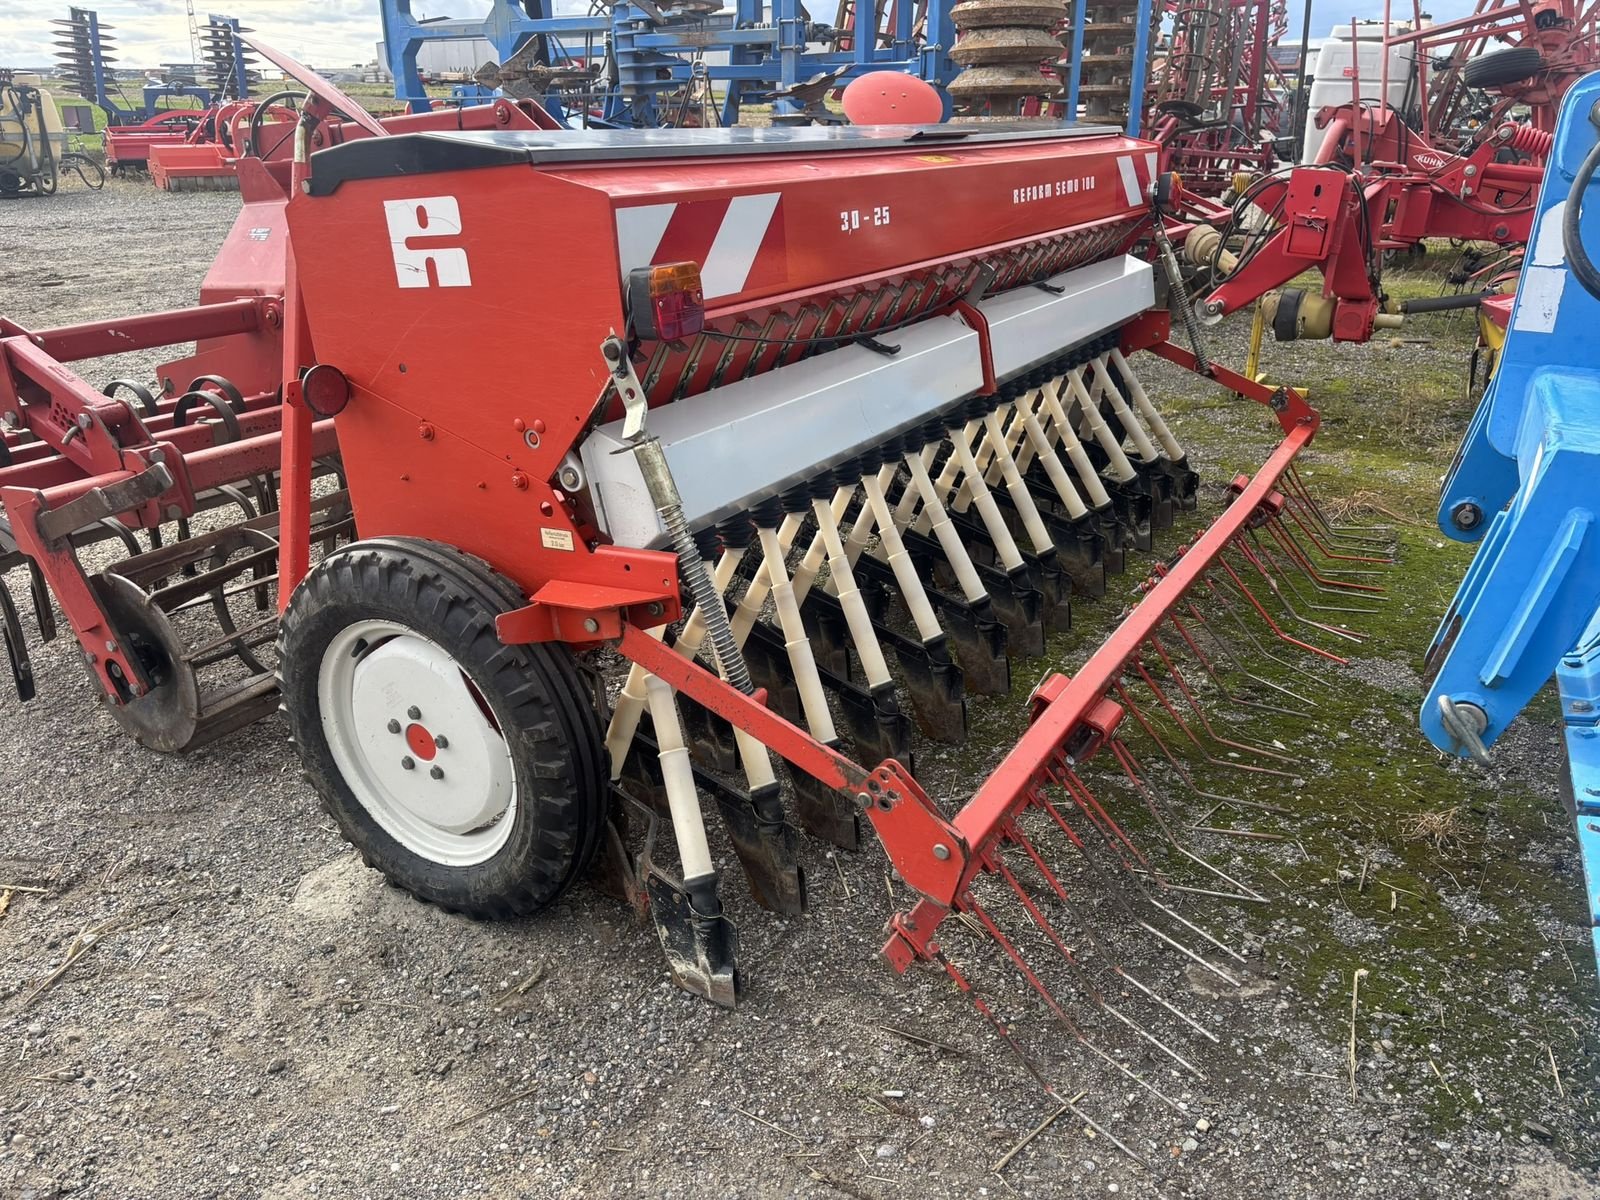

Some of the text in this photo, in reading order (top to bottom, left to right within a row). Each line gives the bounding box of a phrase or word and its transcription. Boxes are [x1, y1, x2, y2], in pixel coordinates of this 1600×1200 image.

[1417, 154, 1443, 168] KUHN
[1013, 176, 1095, 204] REFORM SEMO 100
[874, 206, 890, 226] 25
